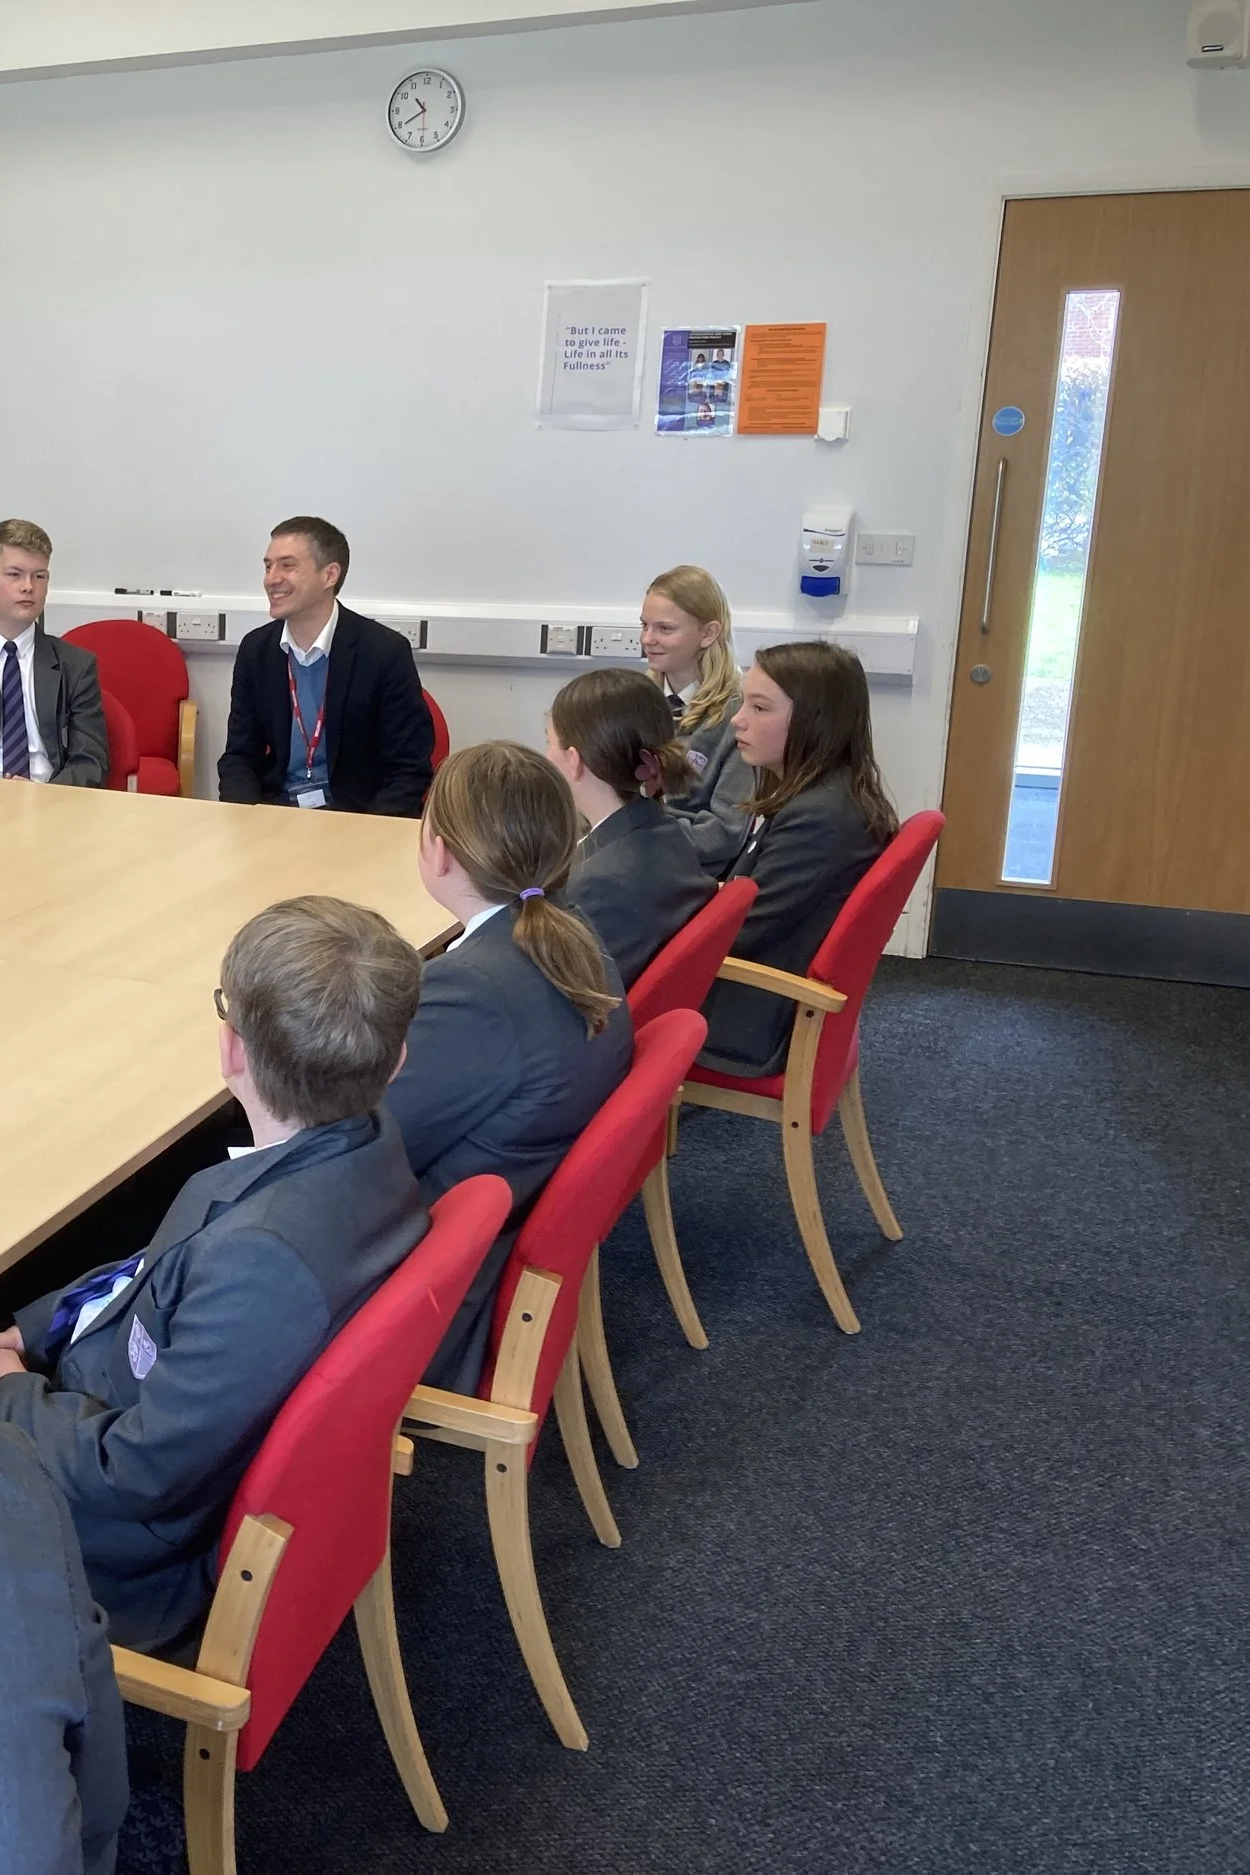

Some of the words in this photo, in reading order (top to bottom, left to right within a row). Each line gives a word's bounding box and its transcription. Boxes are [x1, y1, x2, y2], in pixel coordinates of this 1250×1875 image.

[401, 92, 409, 100] 10
[407, 131, 412, 140] 7
[434, 131, 439, 139] 5
[566, 326, 589, 335] "But
[592, 326, 595, 335] I
[598, 327, 627, 335] came
[578, 338, 600, 349] give
[603, 337, 620, 347] life
[564, 349, 584, 358] Life
[586, 349, 596, 358] in
[599, 349, 612, 358] all
[615, 350, 629, 358] Its
[563, 361, 611, 370] Fullness"
